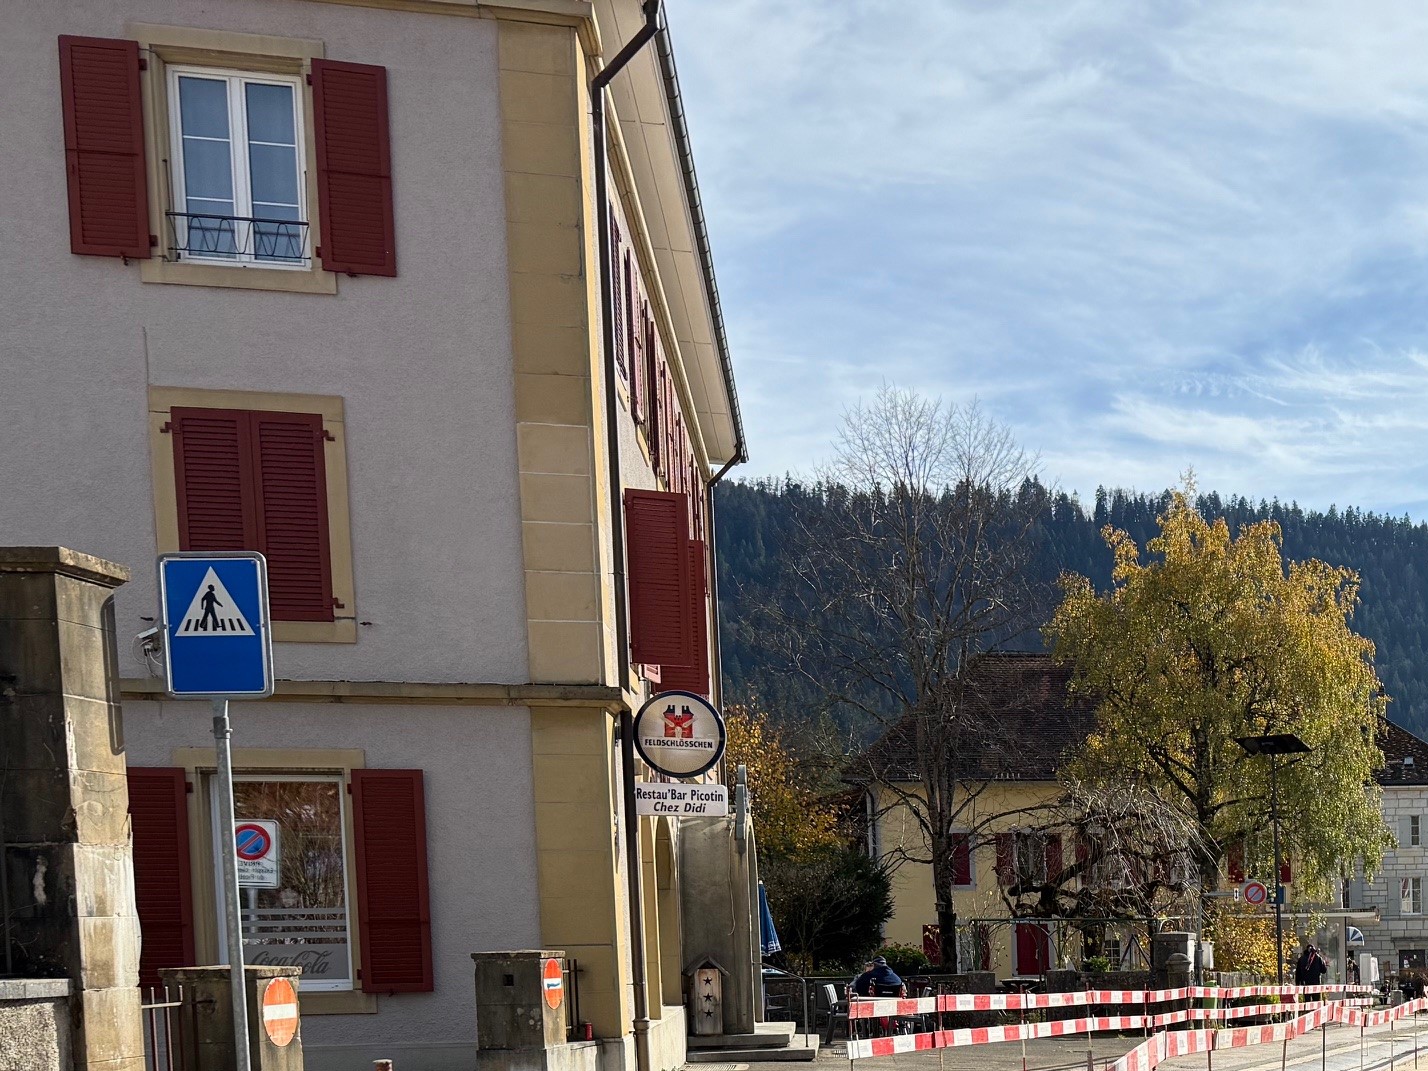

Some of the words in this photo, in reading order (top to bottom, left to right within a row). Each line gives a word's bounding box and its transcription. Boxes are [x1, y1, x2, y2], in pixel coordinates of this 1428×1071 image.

[644, 738, 713, 749] FELDSCHLÖSSCHEN
[636, 788, 687, 800] Restau'Bar
[690, 789, 724, 802] Picotin
[653, 801, 680, 812] Chez
[683, 802, 707, 813] Didi
